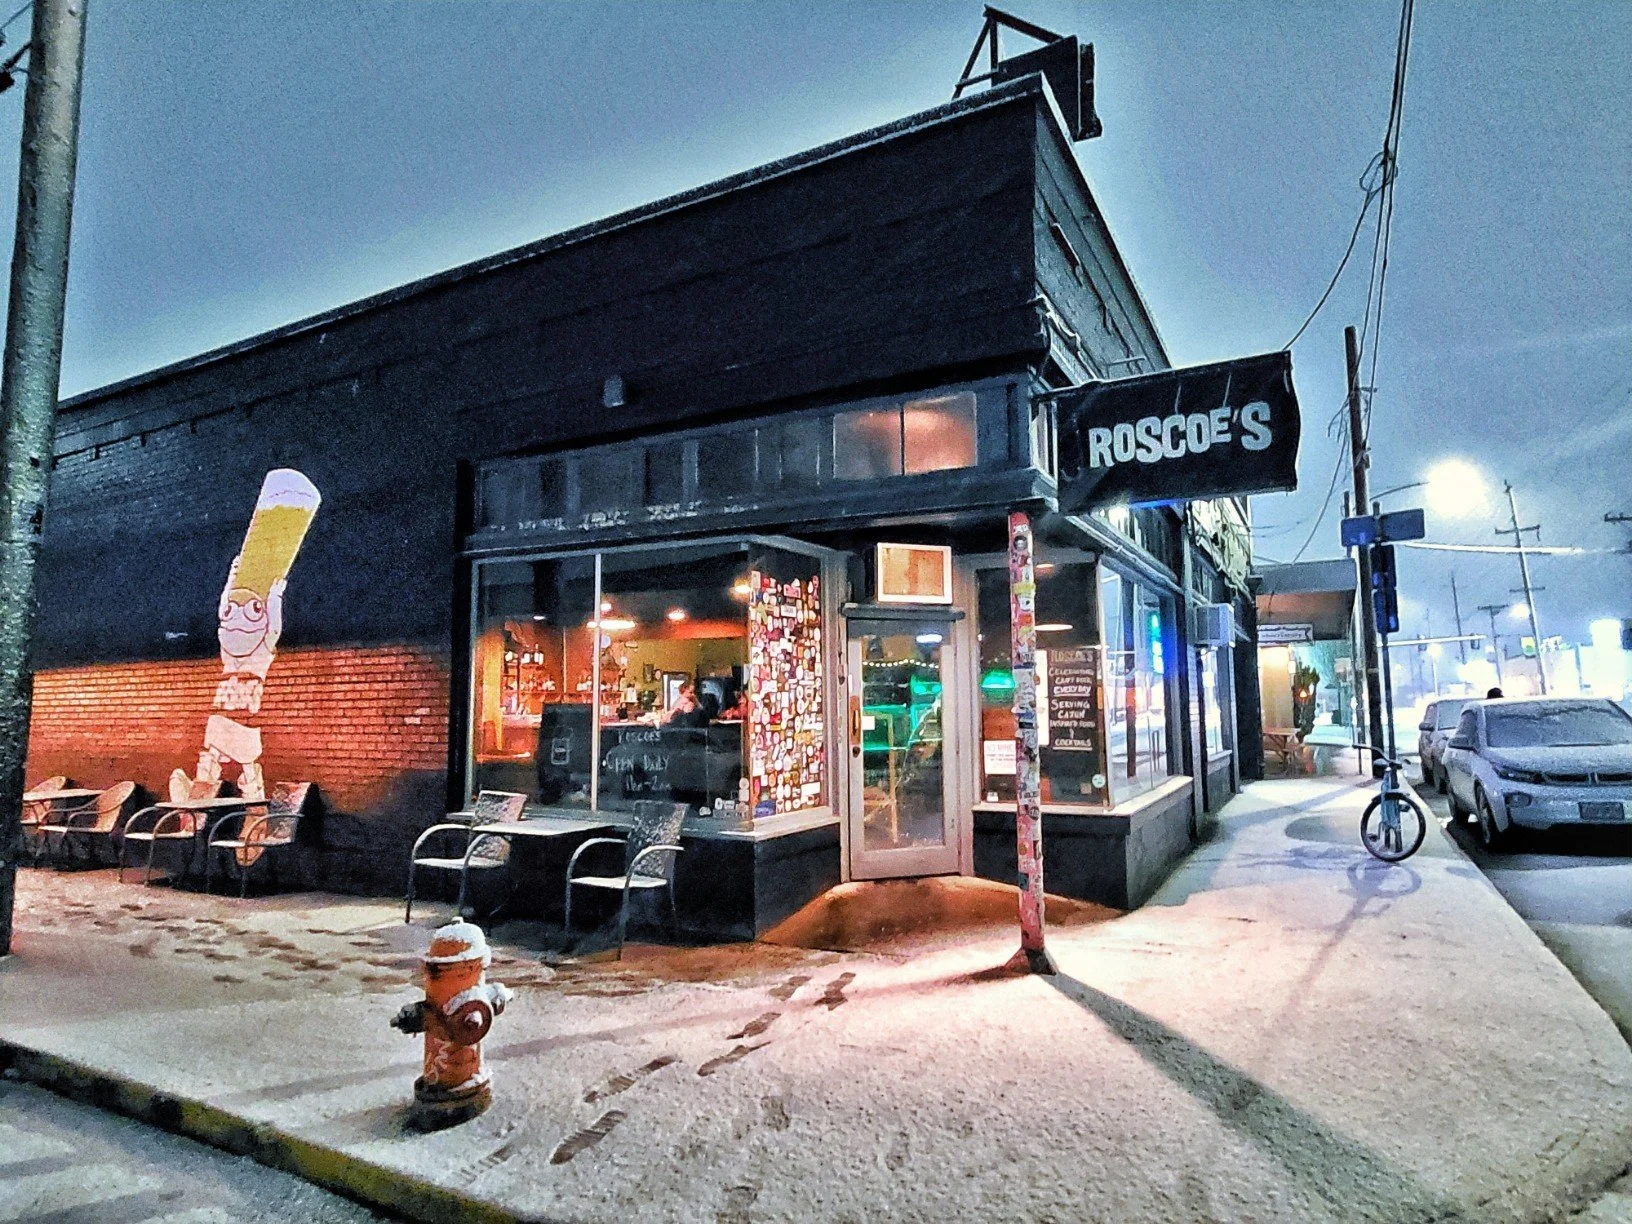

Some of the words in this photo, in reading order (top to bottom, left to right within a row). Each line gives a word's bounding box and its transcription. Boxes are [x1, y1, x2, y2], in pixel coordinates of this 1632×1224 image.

[1088, 401, 1273, 468] ROSCOE'S
[1050, 699, 1091, 711] SERVING
[1058, 709, 1086, 719] CAJUN
[1054, 738, 1092, 747] COCKTAILS
